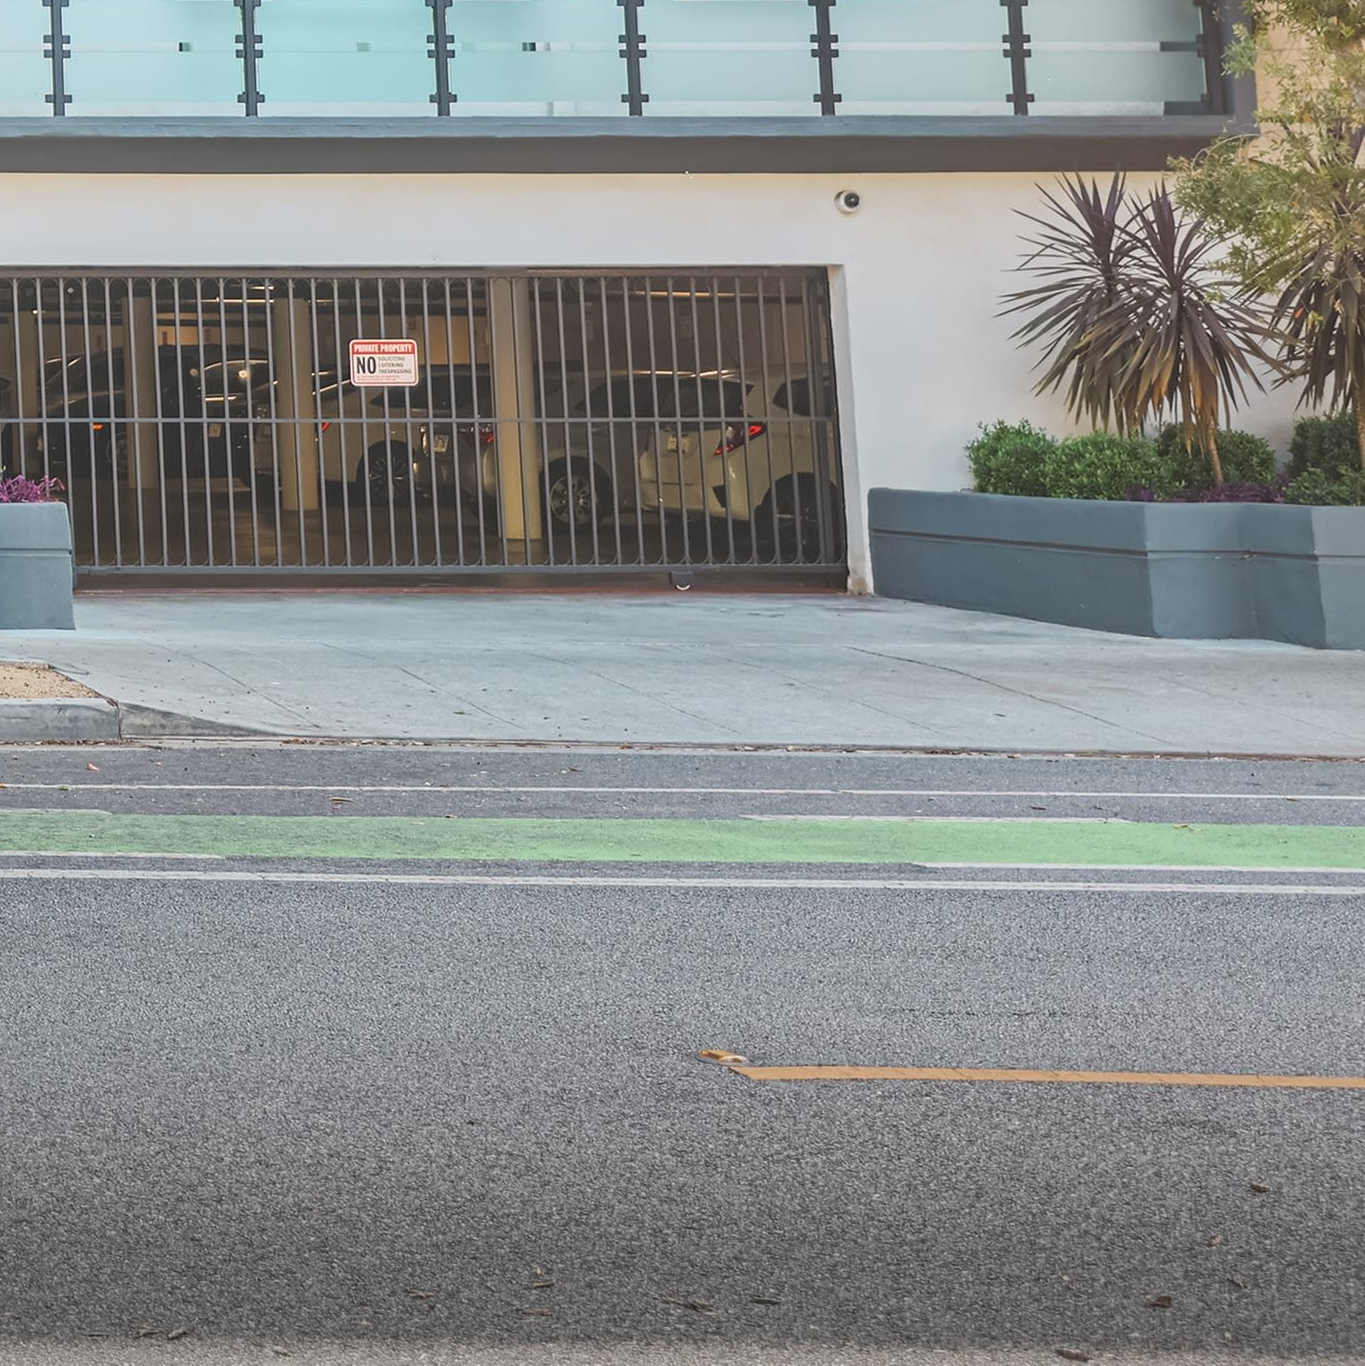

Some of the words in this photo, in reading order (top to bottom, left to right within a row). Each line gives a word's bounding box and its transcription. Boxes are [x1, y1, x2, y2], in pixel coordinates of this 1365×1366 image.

[354, 343, 379, 352] PRIVATE
[380, 343, 412, 352] PROPERTY
[356, 356, 376, 374] NO
